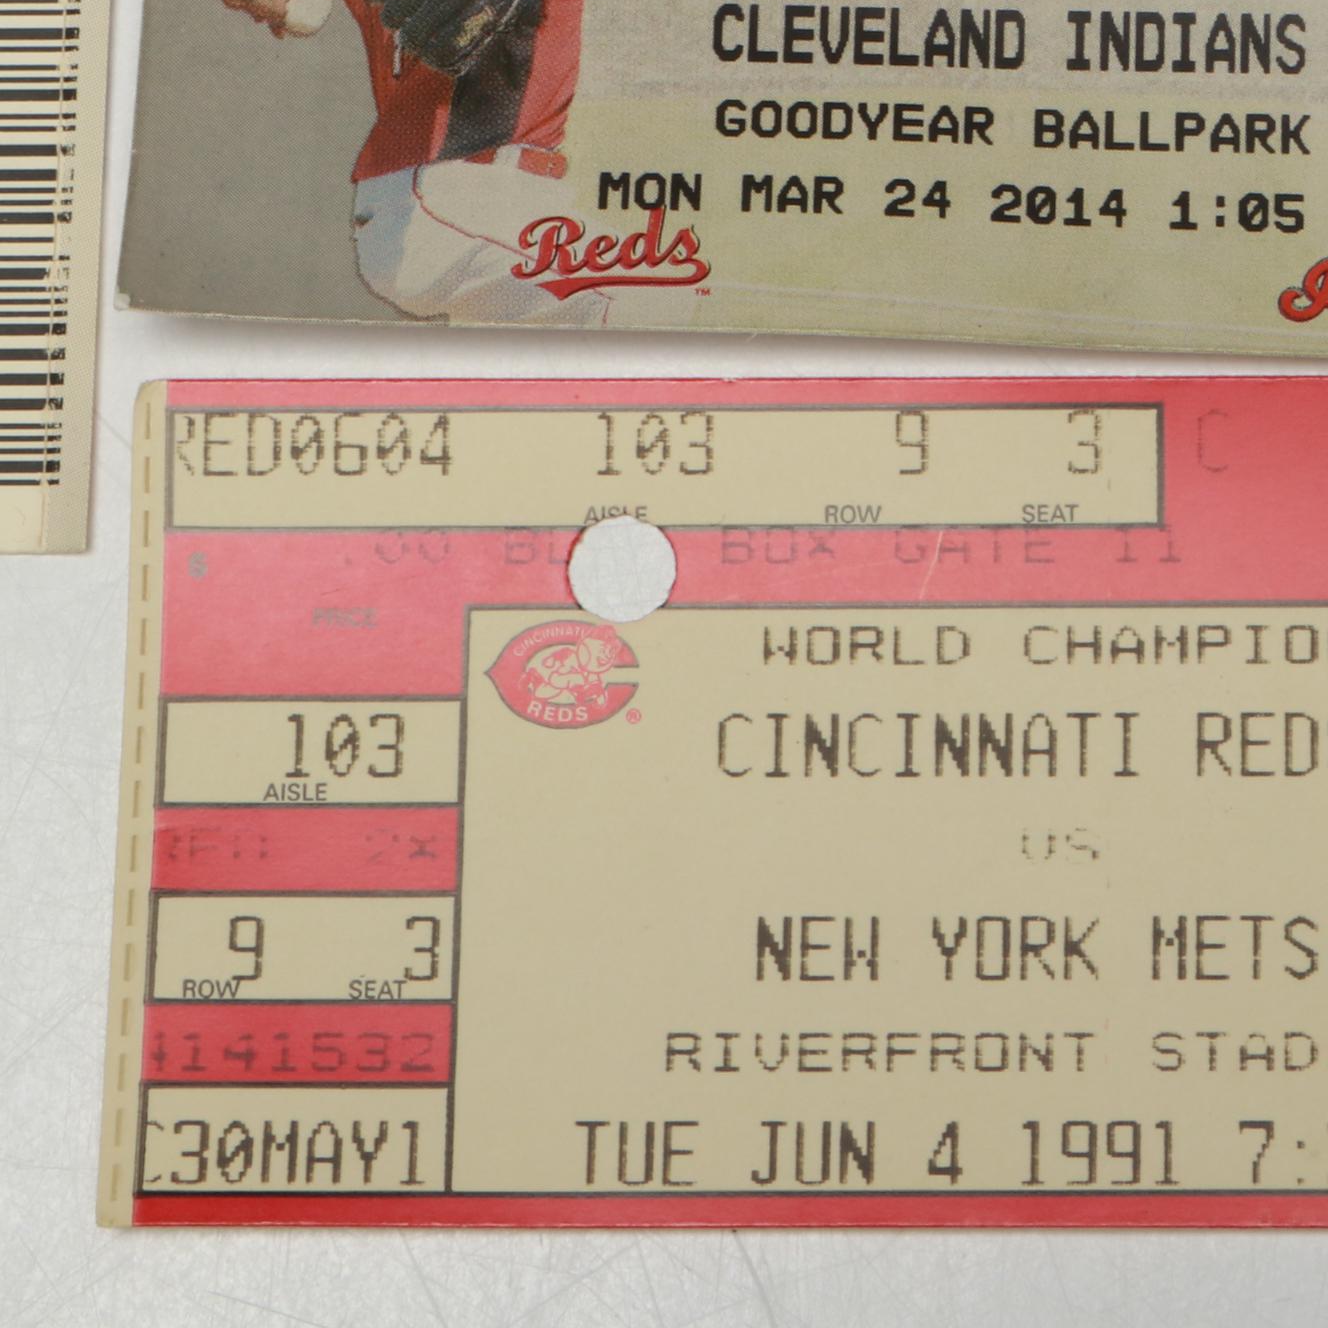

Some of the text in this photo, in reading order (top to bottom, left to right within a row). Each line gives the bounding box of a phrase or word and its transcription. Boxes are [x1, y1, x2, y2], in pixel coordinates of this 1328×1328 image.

[712, 3, 1306, 74] CLEVELAND INDIANS
[715, 98, 1311, 156] GOODYEAR BALLPARK
[599, 172, 703, 211] MON
[741, 175, 844, 215] MAR
[884, 180, 951, 221] 24
[991, 185, 1126, 228] 2014
[1168, 191, 1306, 233] 1:05
[596, 412, 712, 475] 103
[896, 410, 928, 474] 9
[1068, 410, 1100, 473] 3
[585, 505, 1078, 526] AISLE ROW SEAT
[764, 626, 971, 665] WORLD
[527, 701, 588, 721] REDS
[285, 714, 405, 778] 103
[718, 712, 1139, 777] CINCINNATI
[263, 783, 327, 801] AISLE
[229, 916, 439, 981] 9 3
[757, 916, 1319, 981] NEW YORK METS
[183, 980, 407, 999] ROW SEAT
[665, 1034, 1095, 1072] RIVERFRONT
[575, 1121, 699, 1186] TUE
[750, 1121, 875, 1186] JUN
[928, 1121, 963, 1185] 4
[1023, 1121, 1179, 1185] 1991
